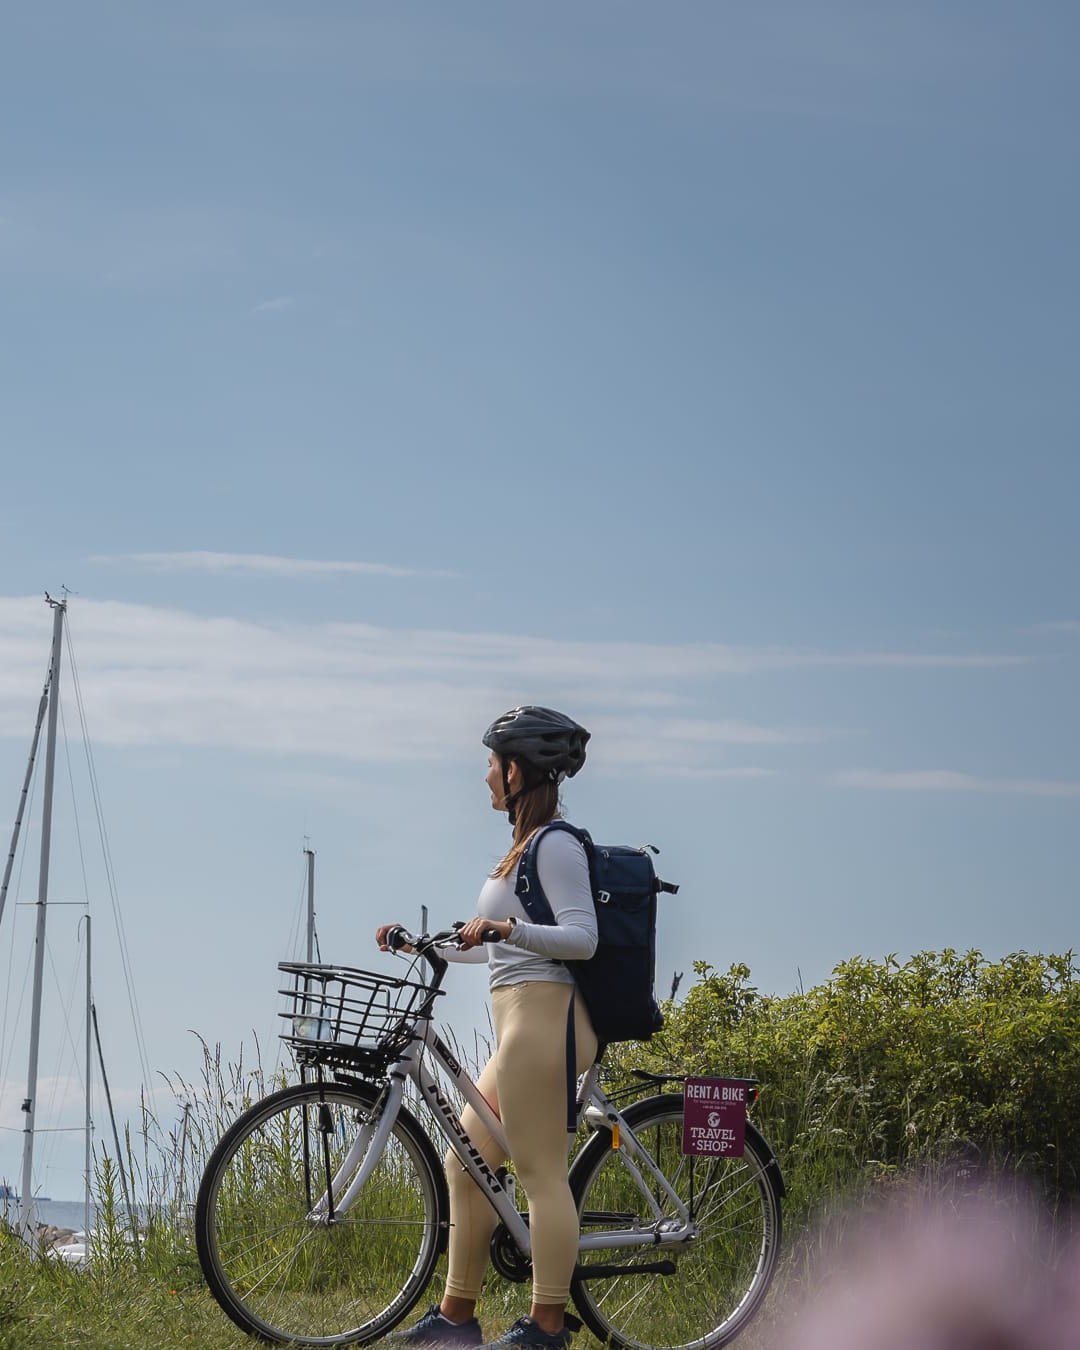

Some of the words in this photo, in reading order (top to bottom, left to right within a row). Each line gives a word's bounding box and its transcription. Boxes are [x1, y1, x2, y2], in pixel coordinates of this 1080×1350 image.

[687, 1085, 712, 1100] RENT
[713, 1086, 720, 1100] A
[722, 1087, 745, 1102] BIKE
[427, 1084, 503, 1194] NISHIKI
[690, 1127, 736, 1141] TRAVEL
[696, 1139, 728, 1152] SHOP
